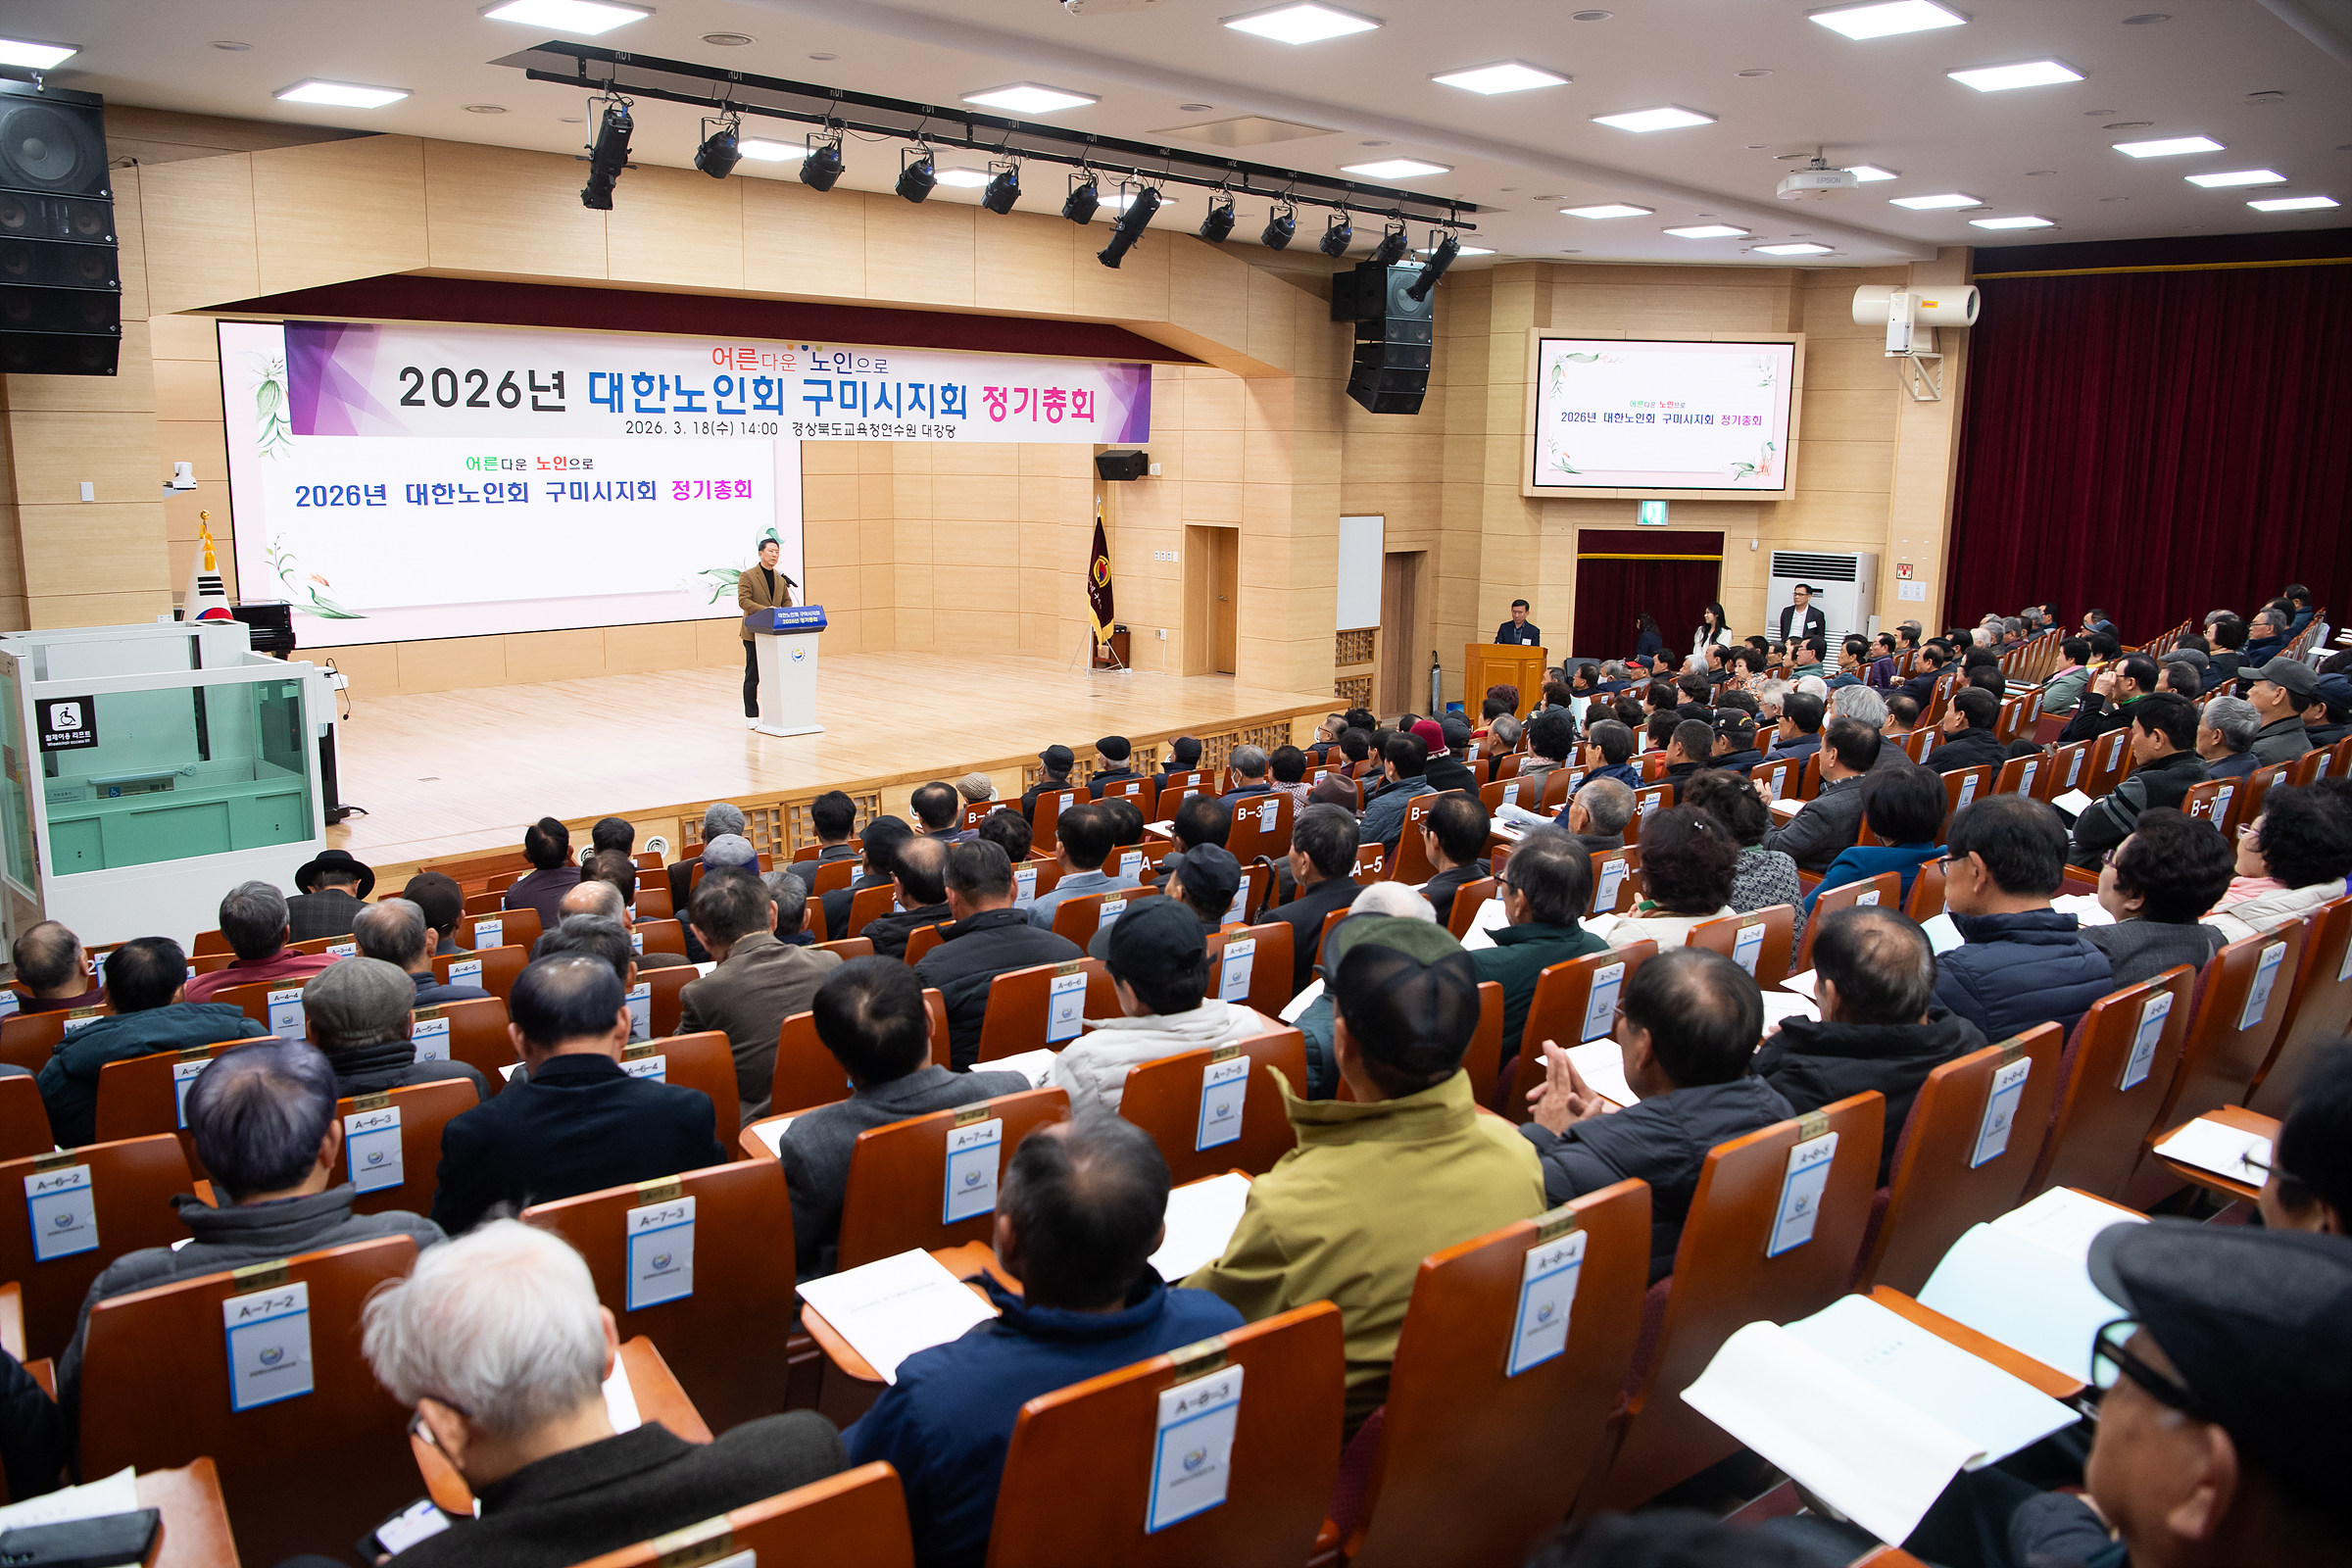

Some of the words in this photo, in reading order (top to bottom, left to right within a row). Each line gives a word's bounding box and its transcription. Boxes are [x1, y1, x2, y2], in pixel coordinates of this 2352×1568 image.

[712, 347, 799, 372] 어른다운
[809, 352, 890, 375] 노인으로
[399, 366, 566, 413] 2026년
[588, 370, 785, 416] 대한노인회
[802, 377, 967, 420] 구미시지회
[982, 384, 1095, 424] 정기총회
[1561, 412, 1596, 423] 2026년
[1603, 412, 1655, 424] 대한노인회
[1662, 413, 1714, 425] 구미시지회
[625, 420, 668, 439] 2026.
[673, 421, 688, 439] 3.
[694, 420, 735, 442] 18(수)
[741, 422, 779, 437] 14:00
[792, 423, 917, 439] 경상북도교육청연수원
[921, 425, 956, 440] 대강당
[466, 456, 527, 471] 어른다운
[536, 456, 594, 470] 노인으로
[295, 483, 387, 508] 2026년
[405, 481, 529, 507] 대한노인회
[545, 479, 657, 504] 구미시지회
[671, 478, 753, 502] 정기총회
[1238, 805, 1264, 821] B-3
[2190, 796, 2217, 818] B-7
[1348, 855, 1384, 878] A-5
